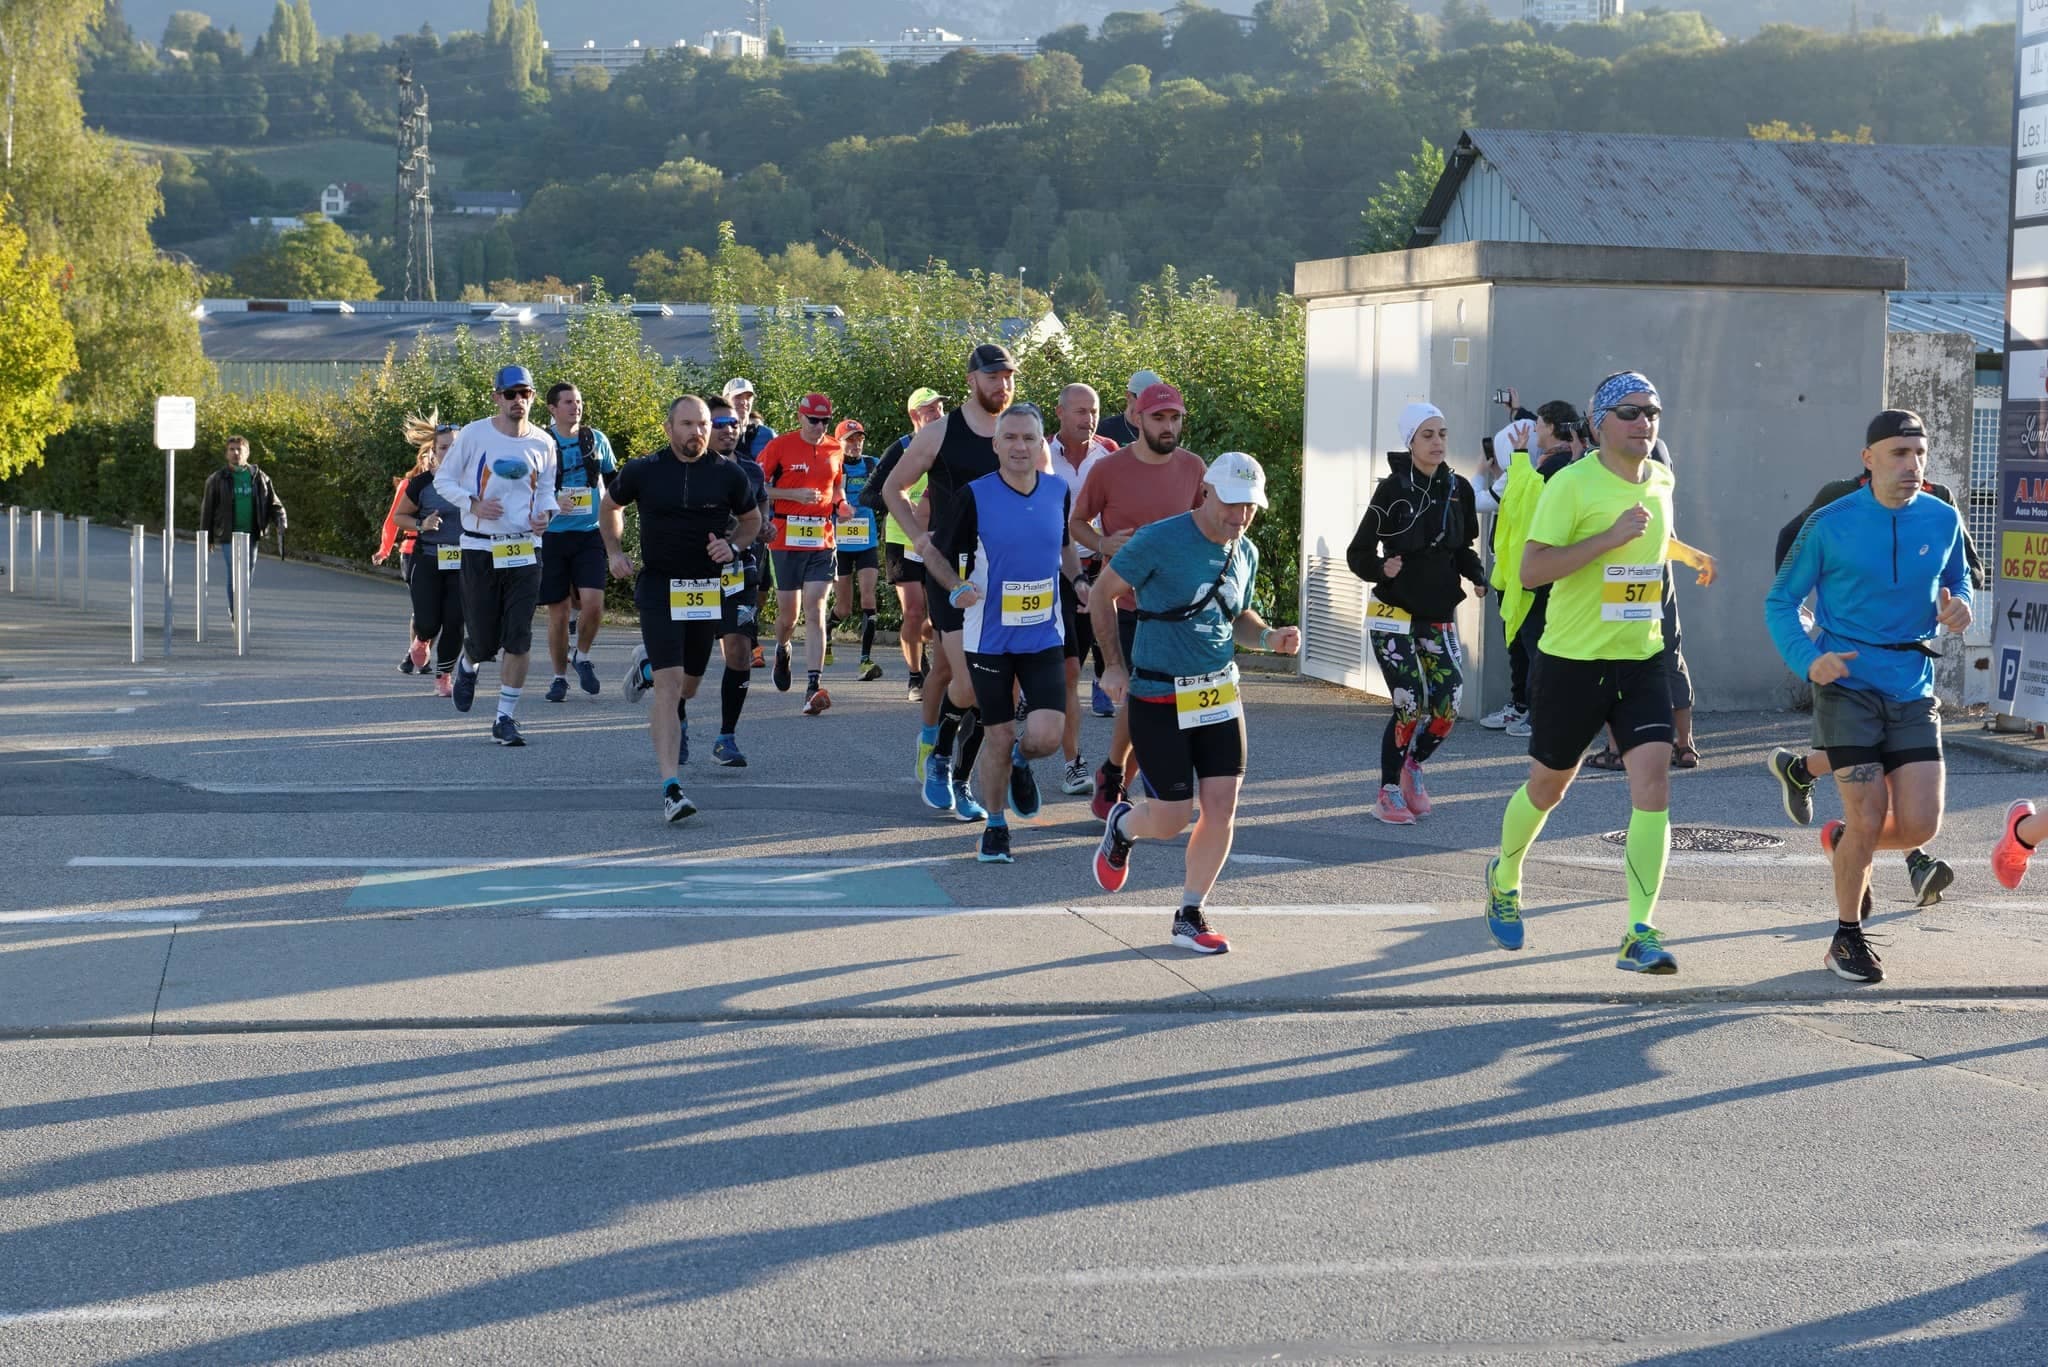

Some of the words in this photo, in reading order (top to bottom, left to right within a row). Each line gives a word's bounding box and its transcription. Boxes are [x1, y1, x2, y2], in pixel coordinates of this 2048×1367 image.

[2022, 120, 2041, 147] Les
[799, 526, 813, 537] 15
[847, 526, 859, 536] 58
[506, 544, 521, 556] 33
[2025, 536, 2033, 555] A
[2004, 558, 2019, 577] 06
[2023, 559, 2037, 577] 67
[686, 592, 704, 607] 35
[1625, 583, 1647, 602] 57
[1021, 595, 1040, 611] 59
[1376, 603, 1394, 618] 22
[2003, 658, 2016, 692] P
[1198, 688, 1220, 708] 32
